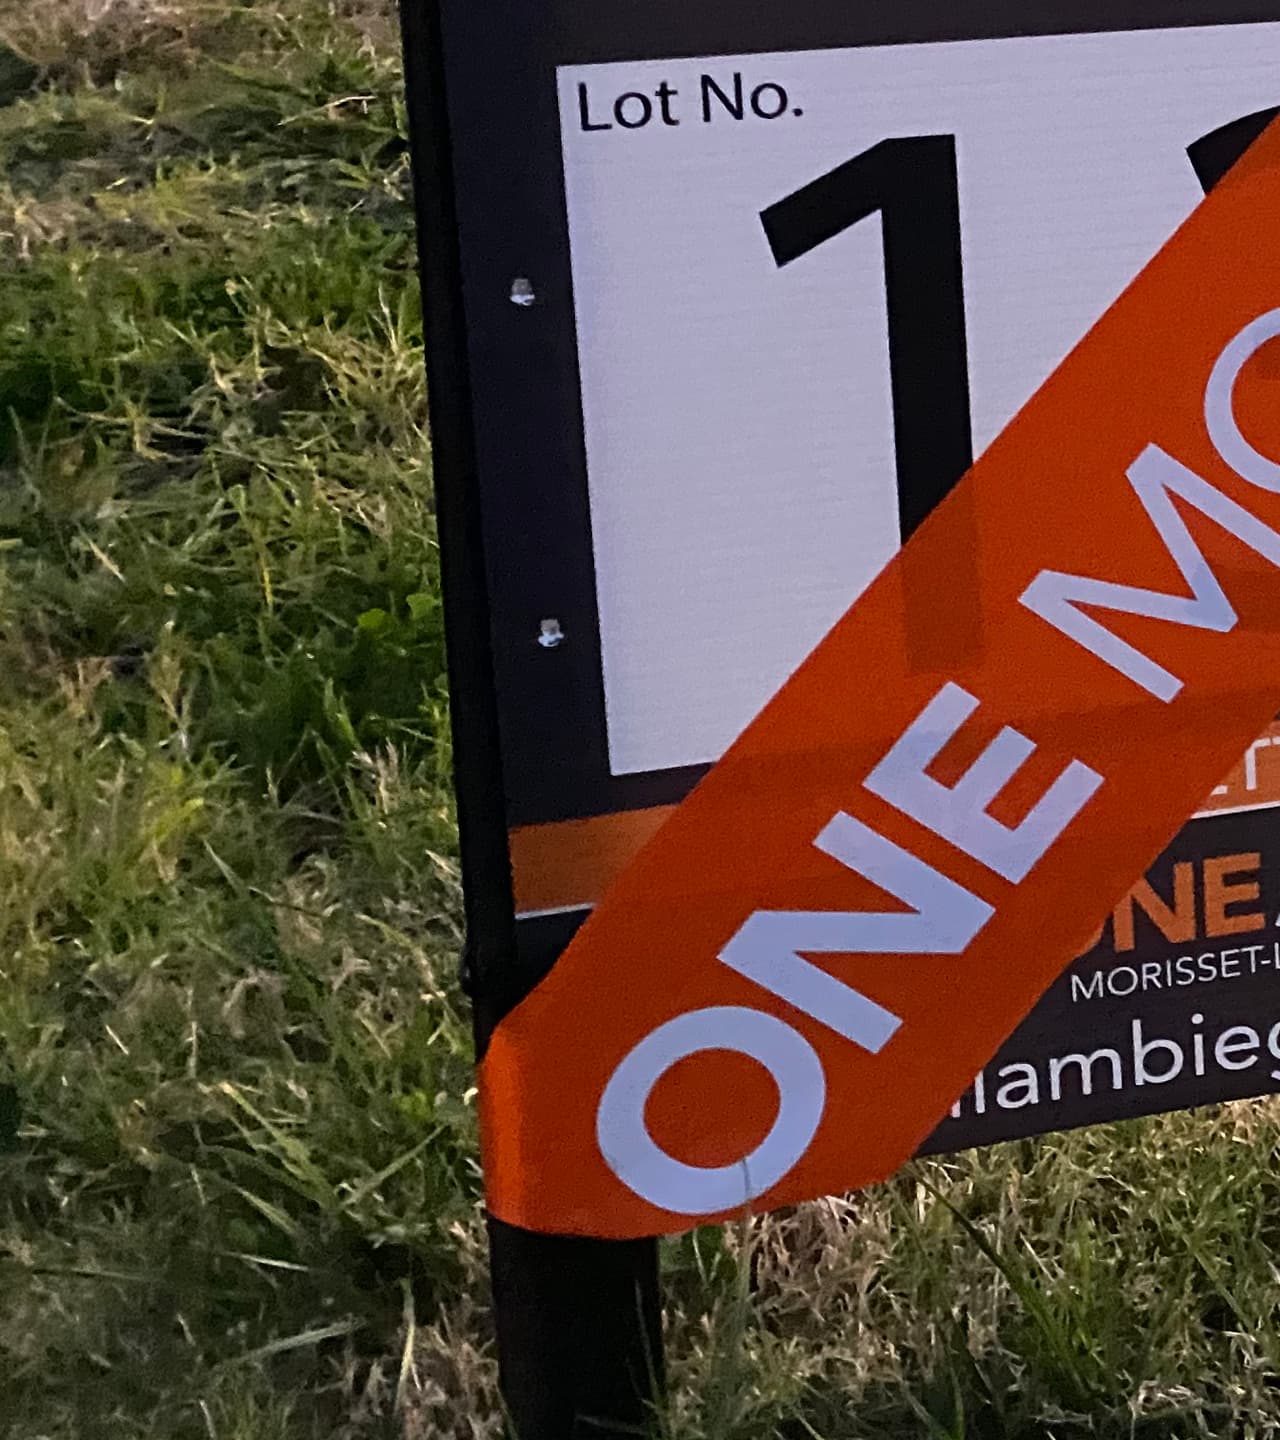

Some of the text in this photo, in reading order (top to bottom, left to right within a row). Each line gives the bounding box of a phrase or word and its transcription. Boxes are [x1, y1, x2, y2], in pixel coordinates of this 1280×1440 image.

[577, 71, 804, 132] Lot No.
[596, 681, 1104, 1215] ONE
[1076, 852, 1267, 958] NE
